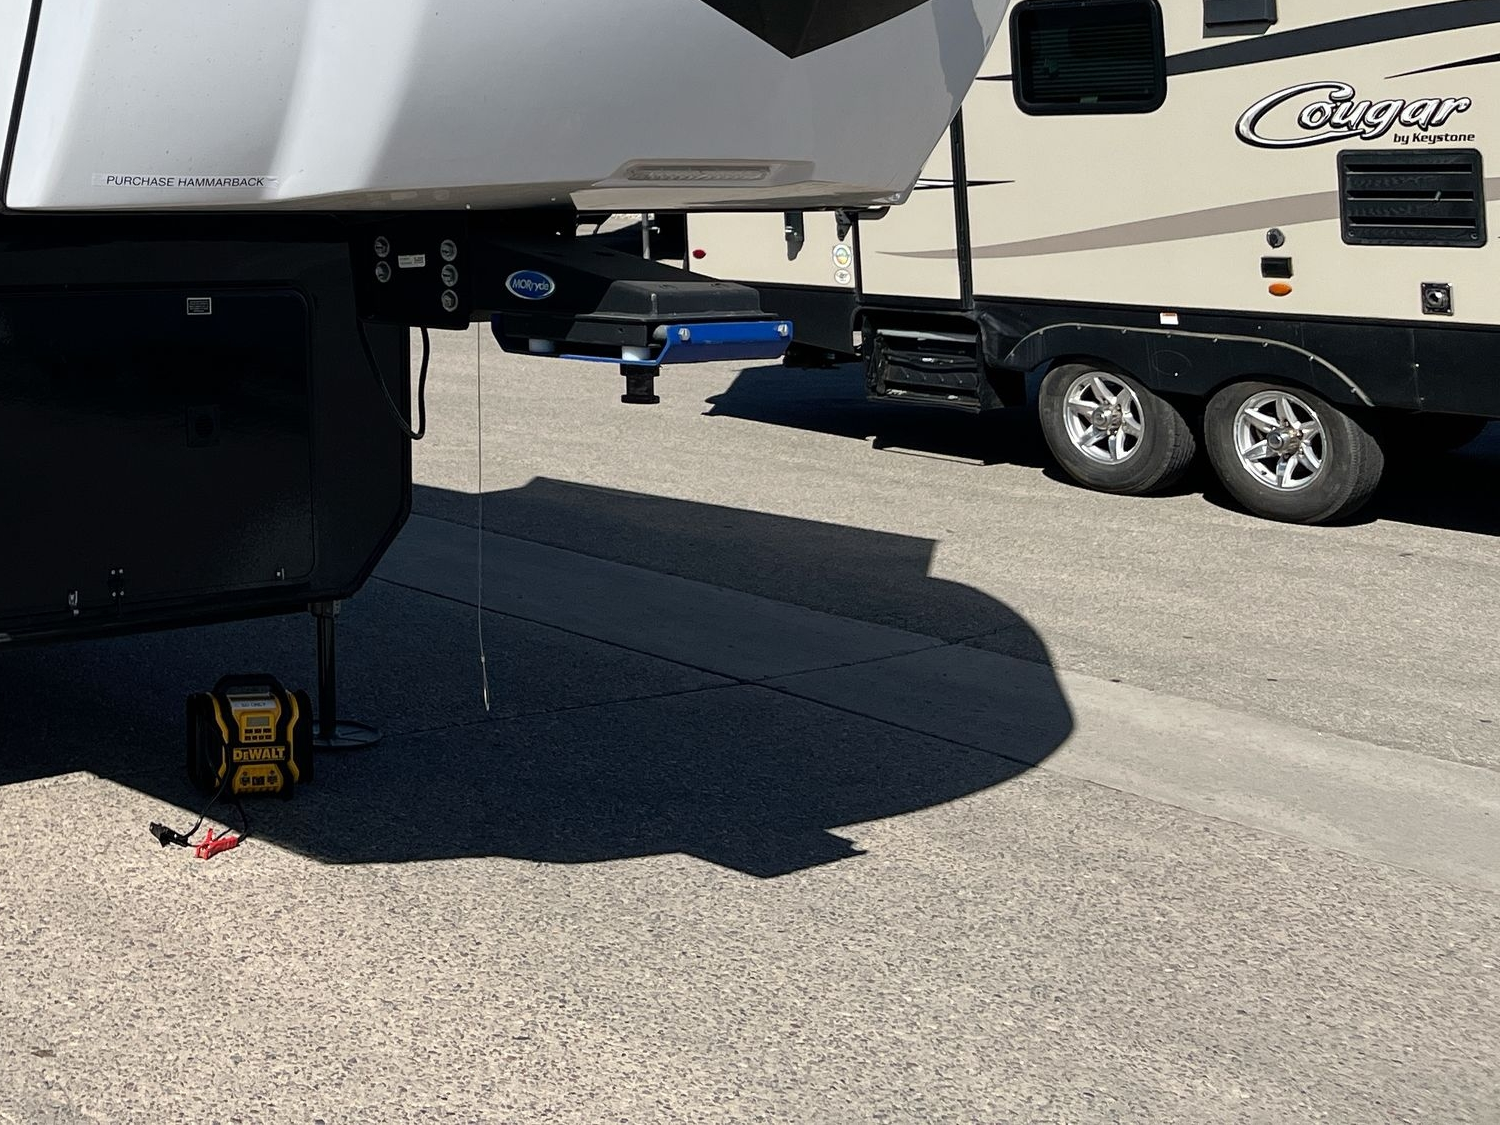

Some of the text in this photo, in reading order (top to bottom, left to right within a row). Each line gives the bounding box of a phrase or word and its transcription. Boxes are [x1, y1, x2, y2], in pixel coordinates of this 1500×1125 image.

[1235, 80, 1473, 150] Cougar
[1393, 131, 1476, 145] by Keystone
[106, 175, 265, 188] PURCHASE HAMMARBACK
